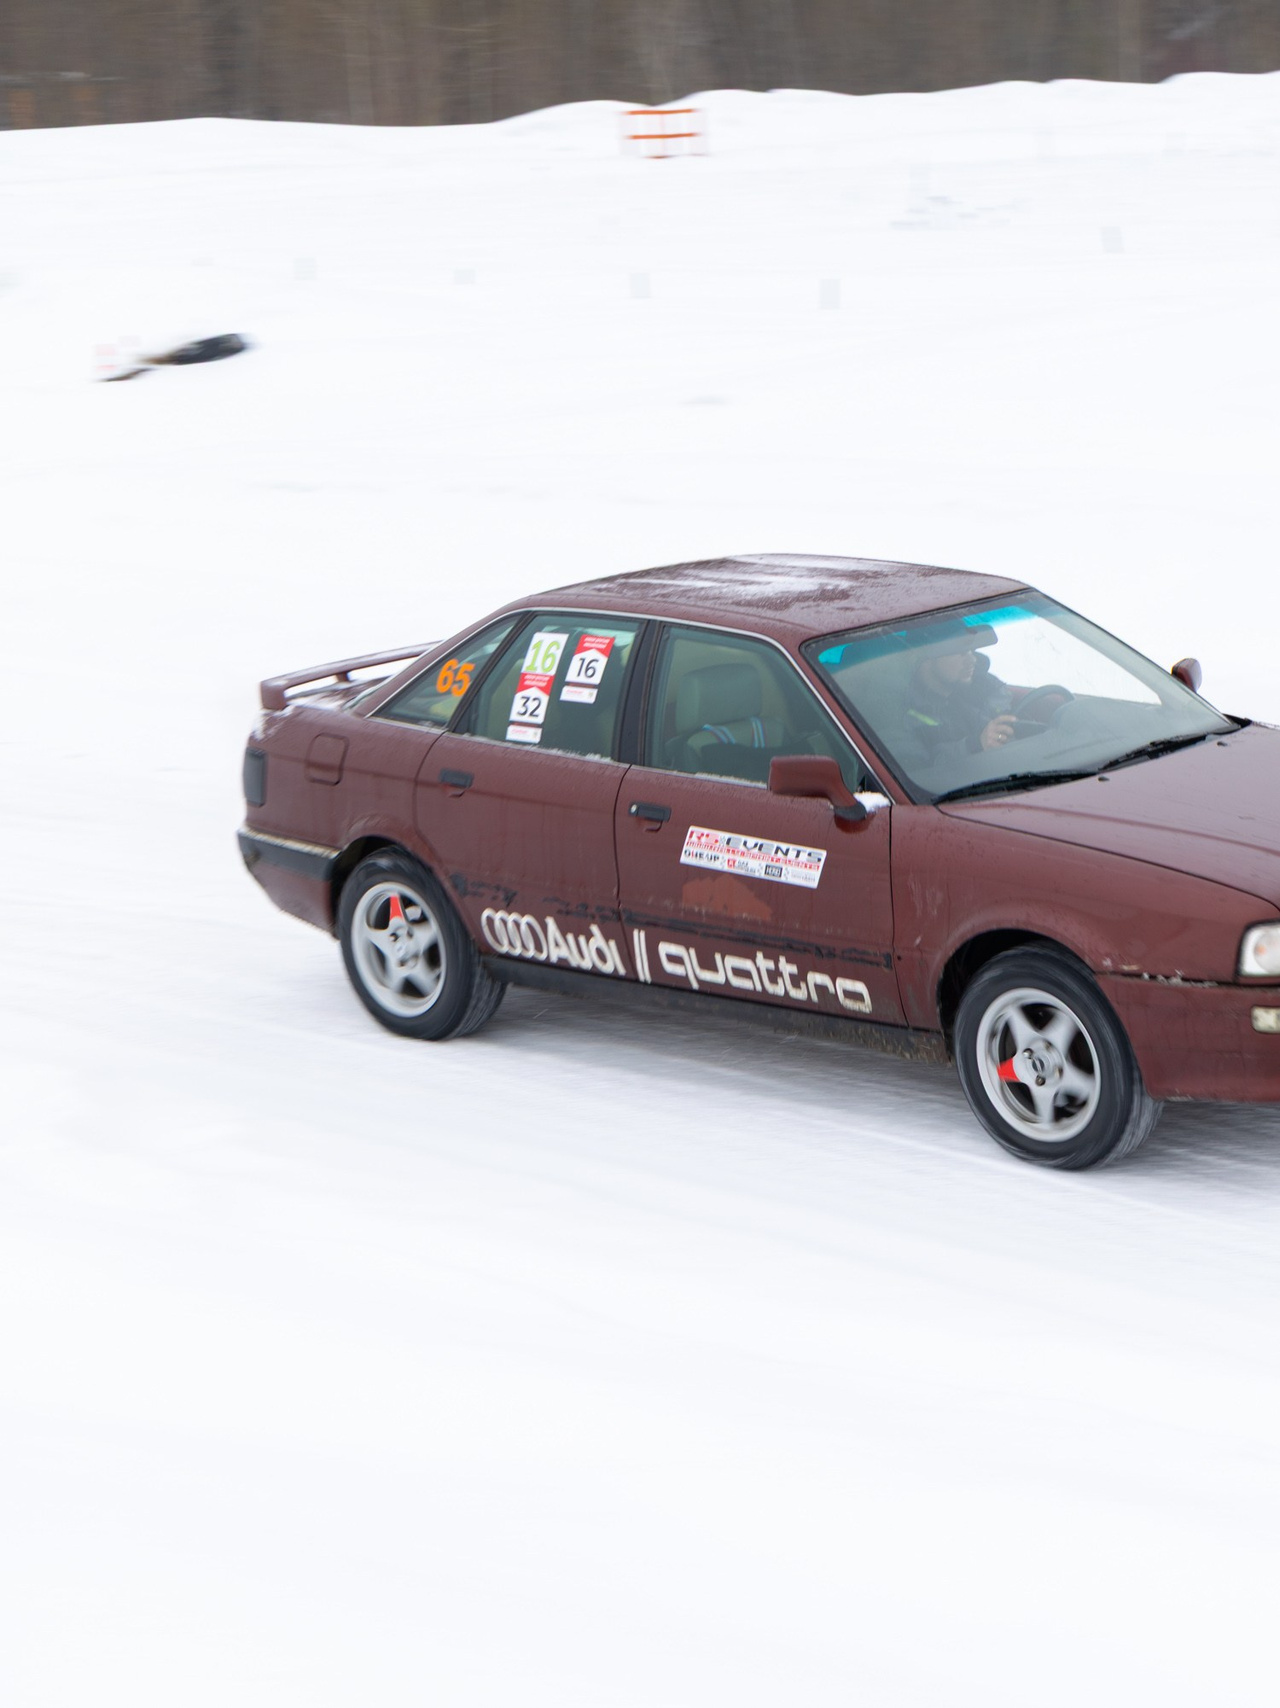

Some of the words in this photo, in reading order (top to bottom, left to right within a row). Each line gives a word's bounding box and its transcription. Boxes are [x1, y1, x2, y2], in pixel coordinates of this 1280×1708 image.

[525, 639, 561, 673] 16
[575, 657, 600, 679] 16
[436, 658, 476, 697] 65
[516, 696, 543, 718] 32
[545, 915, 627, 977] Audi
[658, 940, 873, 1015] quattro
